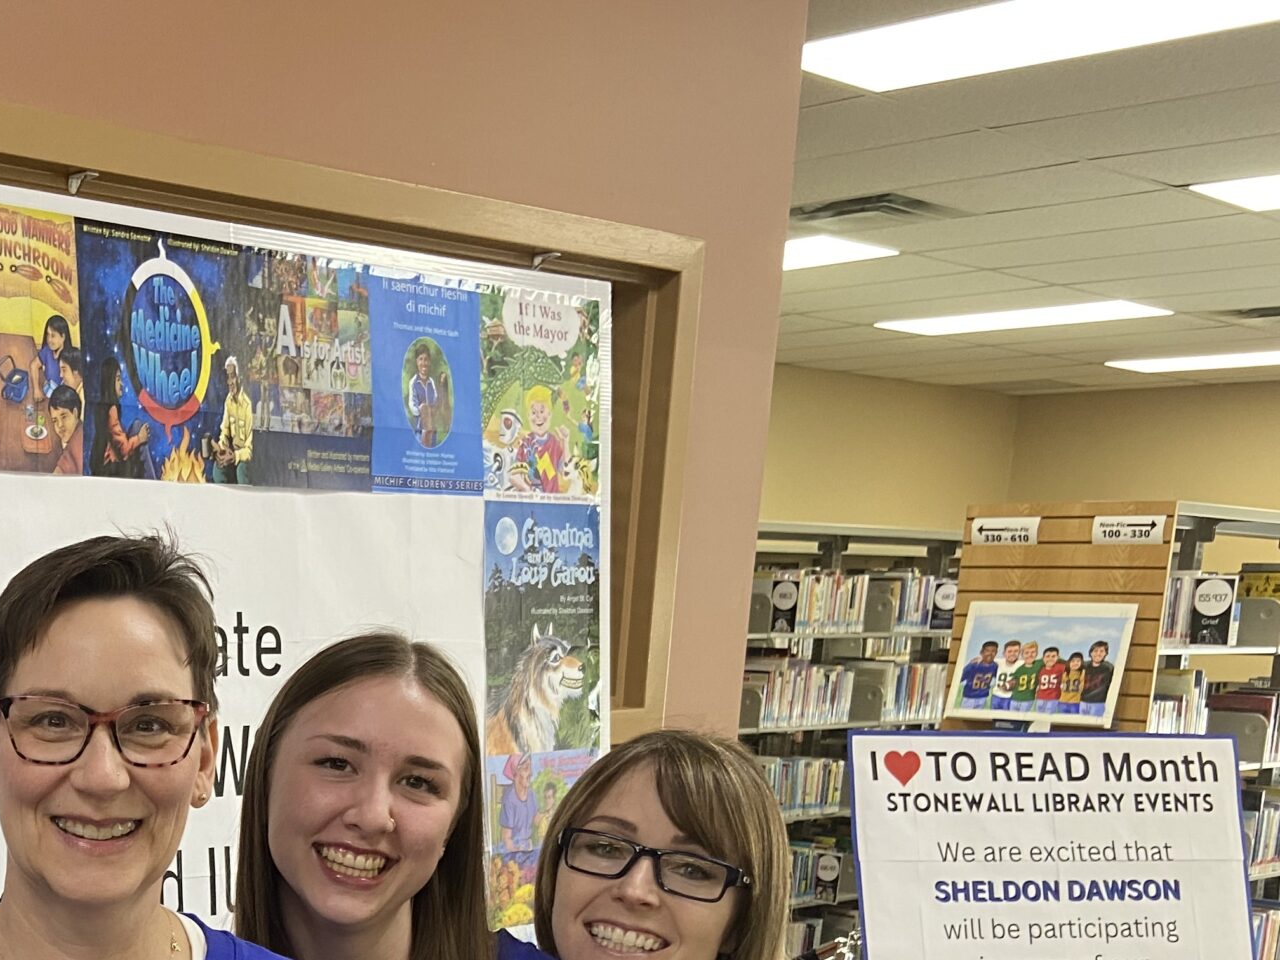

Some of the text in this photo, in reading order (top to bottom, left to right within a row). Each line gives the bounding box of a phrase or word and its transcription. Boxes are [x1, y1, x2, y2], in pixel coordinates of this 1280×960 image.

[152, 276, 175, 306] The
[406, 300, 447, 317] di michif
[130, 305, 201, 350] Medicine
[276, 304, 297, 357] A
[514, 321, 569, 343] the Mayor
[132, 343, 198, 402] Wheel
[374, 476, 484, 491] MICHIF CHILDREN'S SERIES
[522, 517, 593, 550] Grandma
[984, 534, 1002, 543] 330
[1010, 534, 1029, 543] 610
[1102, 529, 1121, 539] 100
[1130, 529, 1151, 539] 330
[510, 557, 596, 589] Loup Garou
[214, 610, 281, 677] ate
[871, 751, 1219, 783] I TO READ Month
[886, 793, 1214, 813] STONEWALL LIBRARY EVENTS
[937, 840, 1175, 863] We are excited that
[160, 849, 184, 913] d
[934, 879, 1181, 902] SHELDON DAWSON
[944, 917, 1180, 945] will be participating
